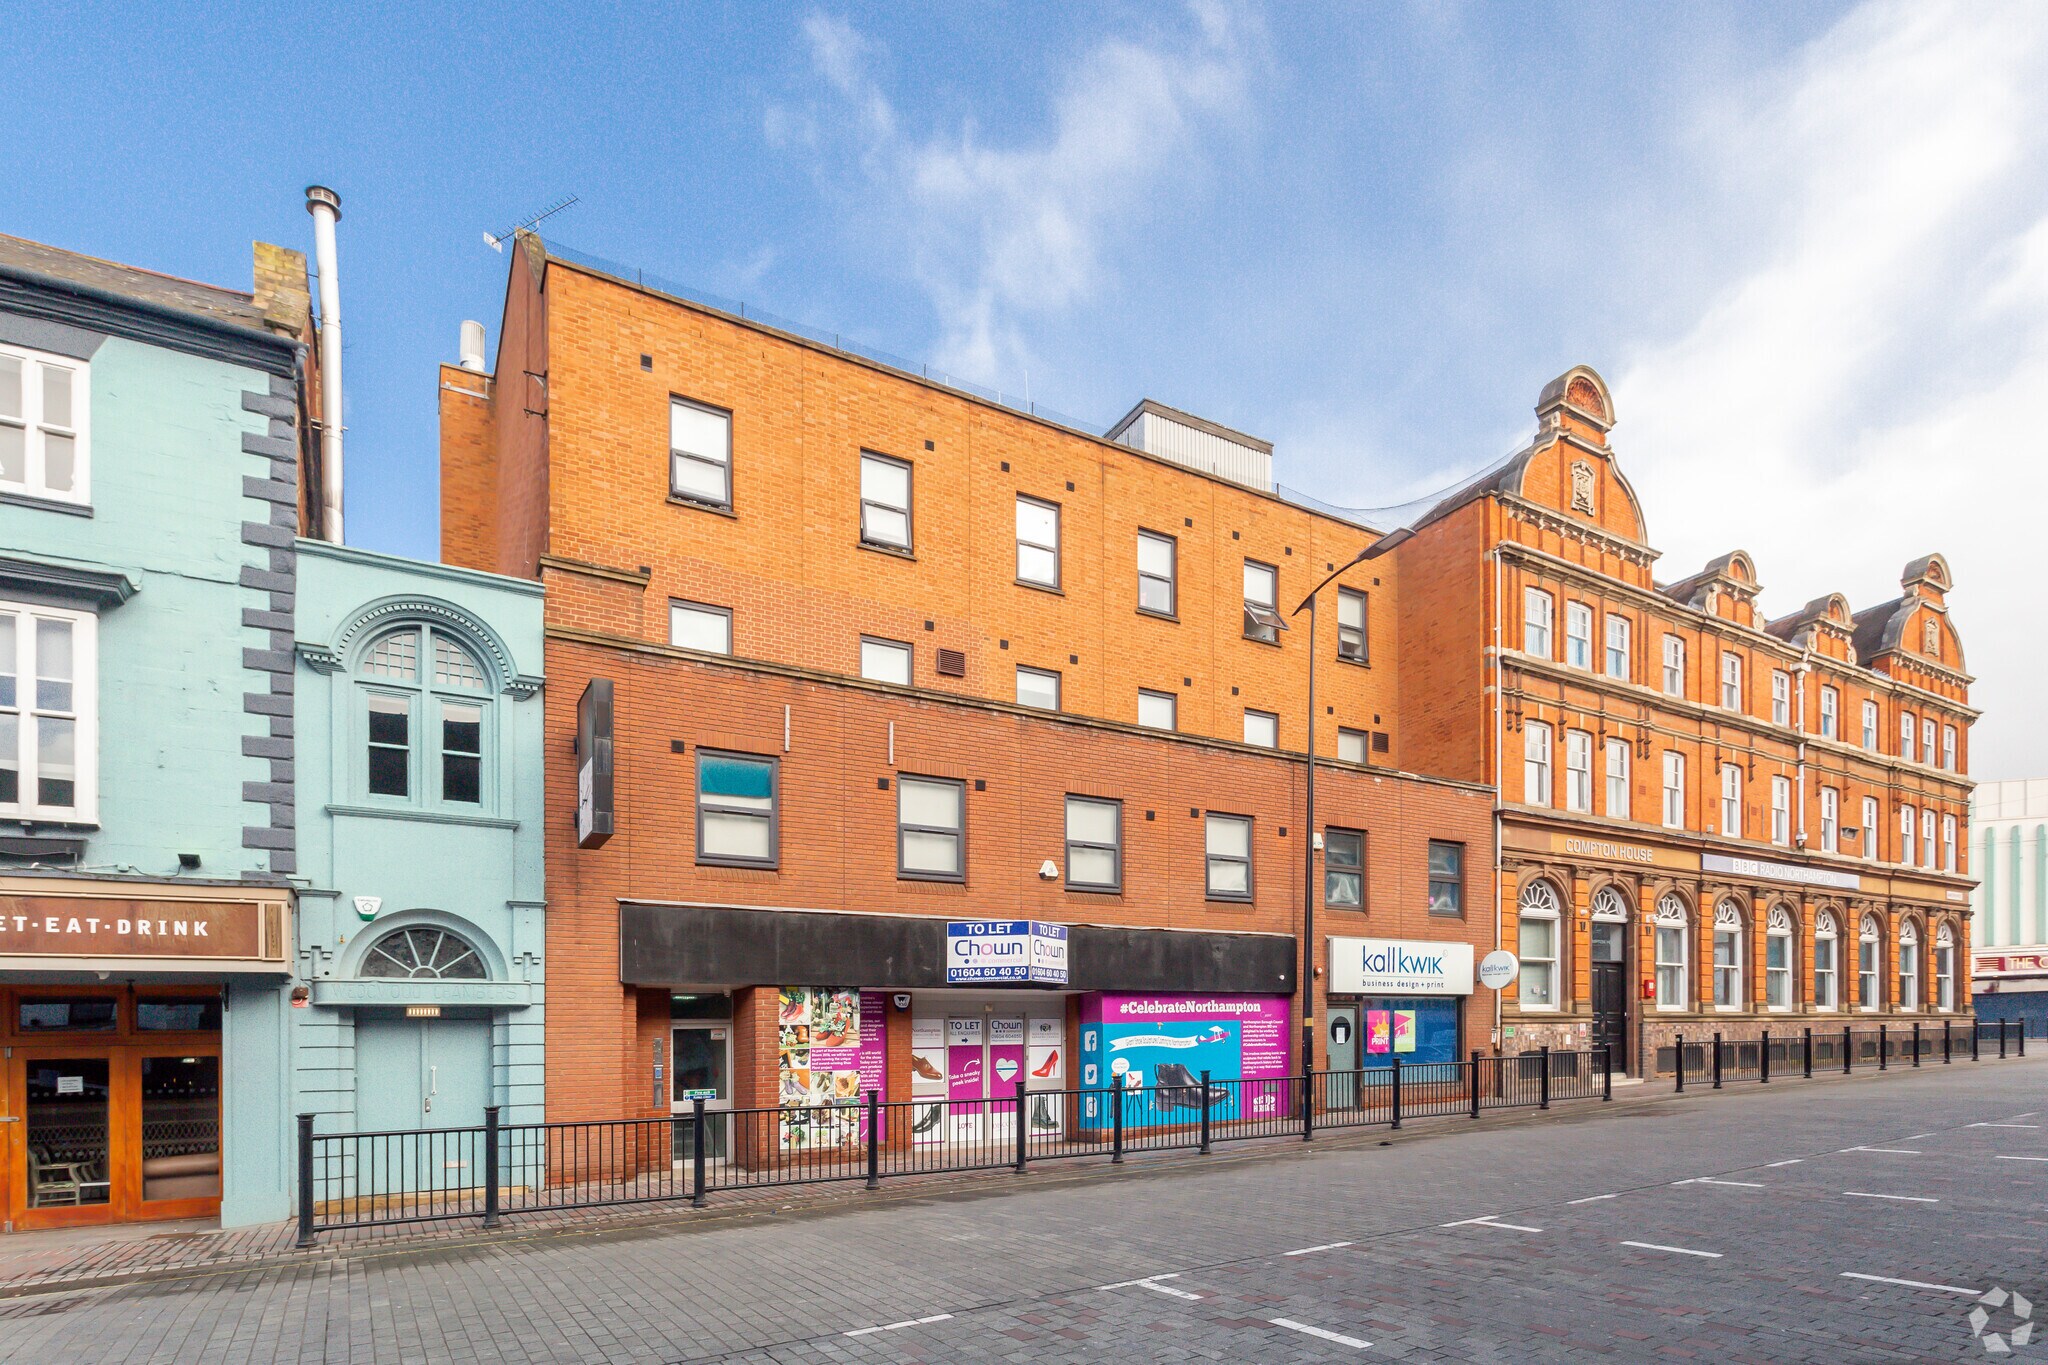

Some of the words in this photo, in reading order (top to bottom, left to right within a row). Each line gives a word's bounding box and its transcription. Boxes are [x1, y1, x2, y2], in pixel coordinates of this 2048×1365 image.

[1566, 838, 1617, 858] COMPTON
[1619, 845, 1653, 862] HOUSE
[1734, 859, 1757, 874] BBC
[1759, 864, 1785, 879] RADIO
[1785, 866, 1837, 885] NORTHAMPTON
[45, 917, 101, 934] EAT
[117, 919, 208, 936] DRINK
[966, 924, 985, 934] TO
[988, 923, 1013, 934] LET
[1039, 924, 1047, 935] TO
[1049, 926, 1060, 937] LET
[955, 940, 1022, 956] Chown
[1034, 939, 1064, 958] Chown
[2008, 957, 2034, 969] THE
[951, 968, 981, 977] 01604
[984, 968, 996, 976] 60
[999, 967, 1010, 976] 40
[1014, 967, 1026, 976] 50
[1032, 967, 1046, 977] 01604
[1046, 969, 1052, 977] 60
[1053, 970, 1060, 978] 40
[1397, 981, 1420, 989] design
[1120, 1001, 1261, 1015] #CelebrateNorthampton
[950, 1022, 962, 1030] TO
[965, 1022, 980, 1030] LET
[992, 1021, 1022, 1030] Chown
